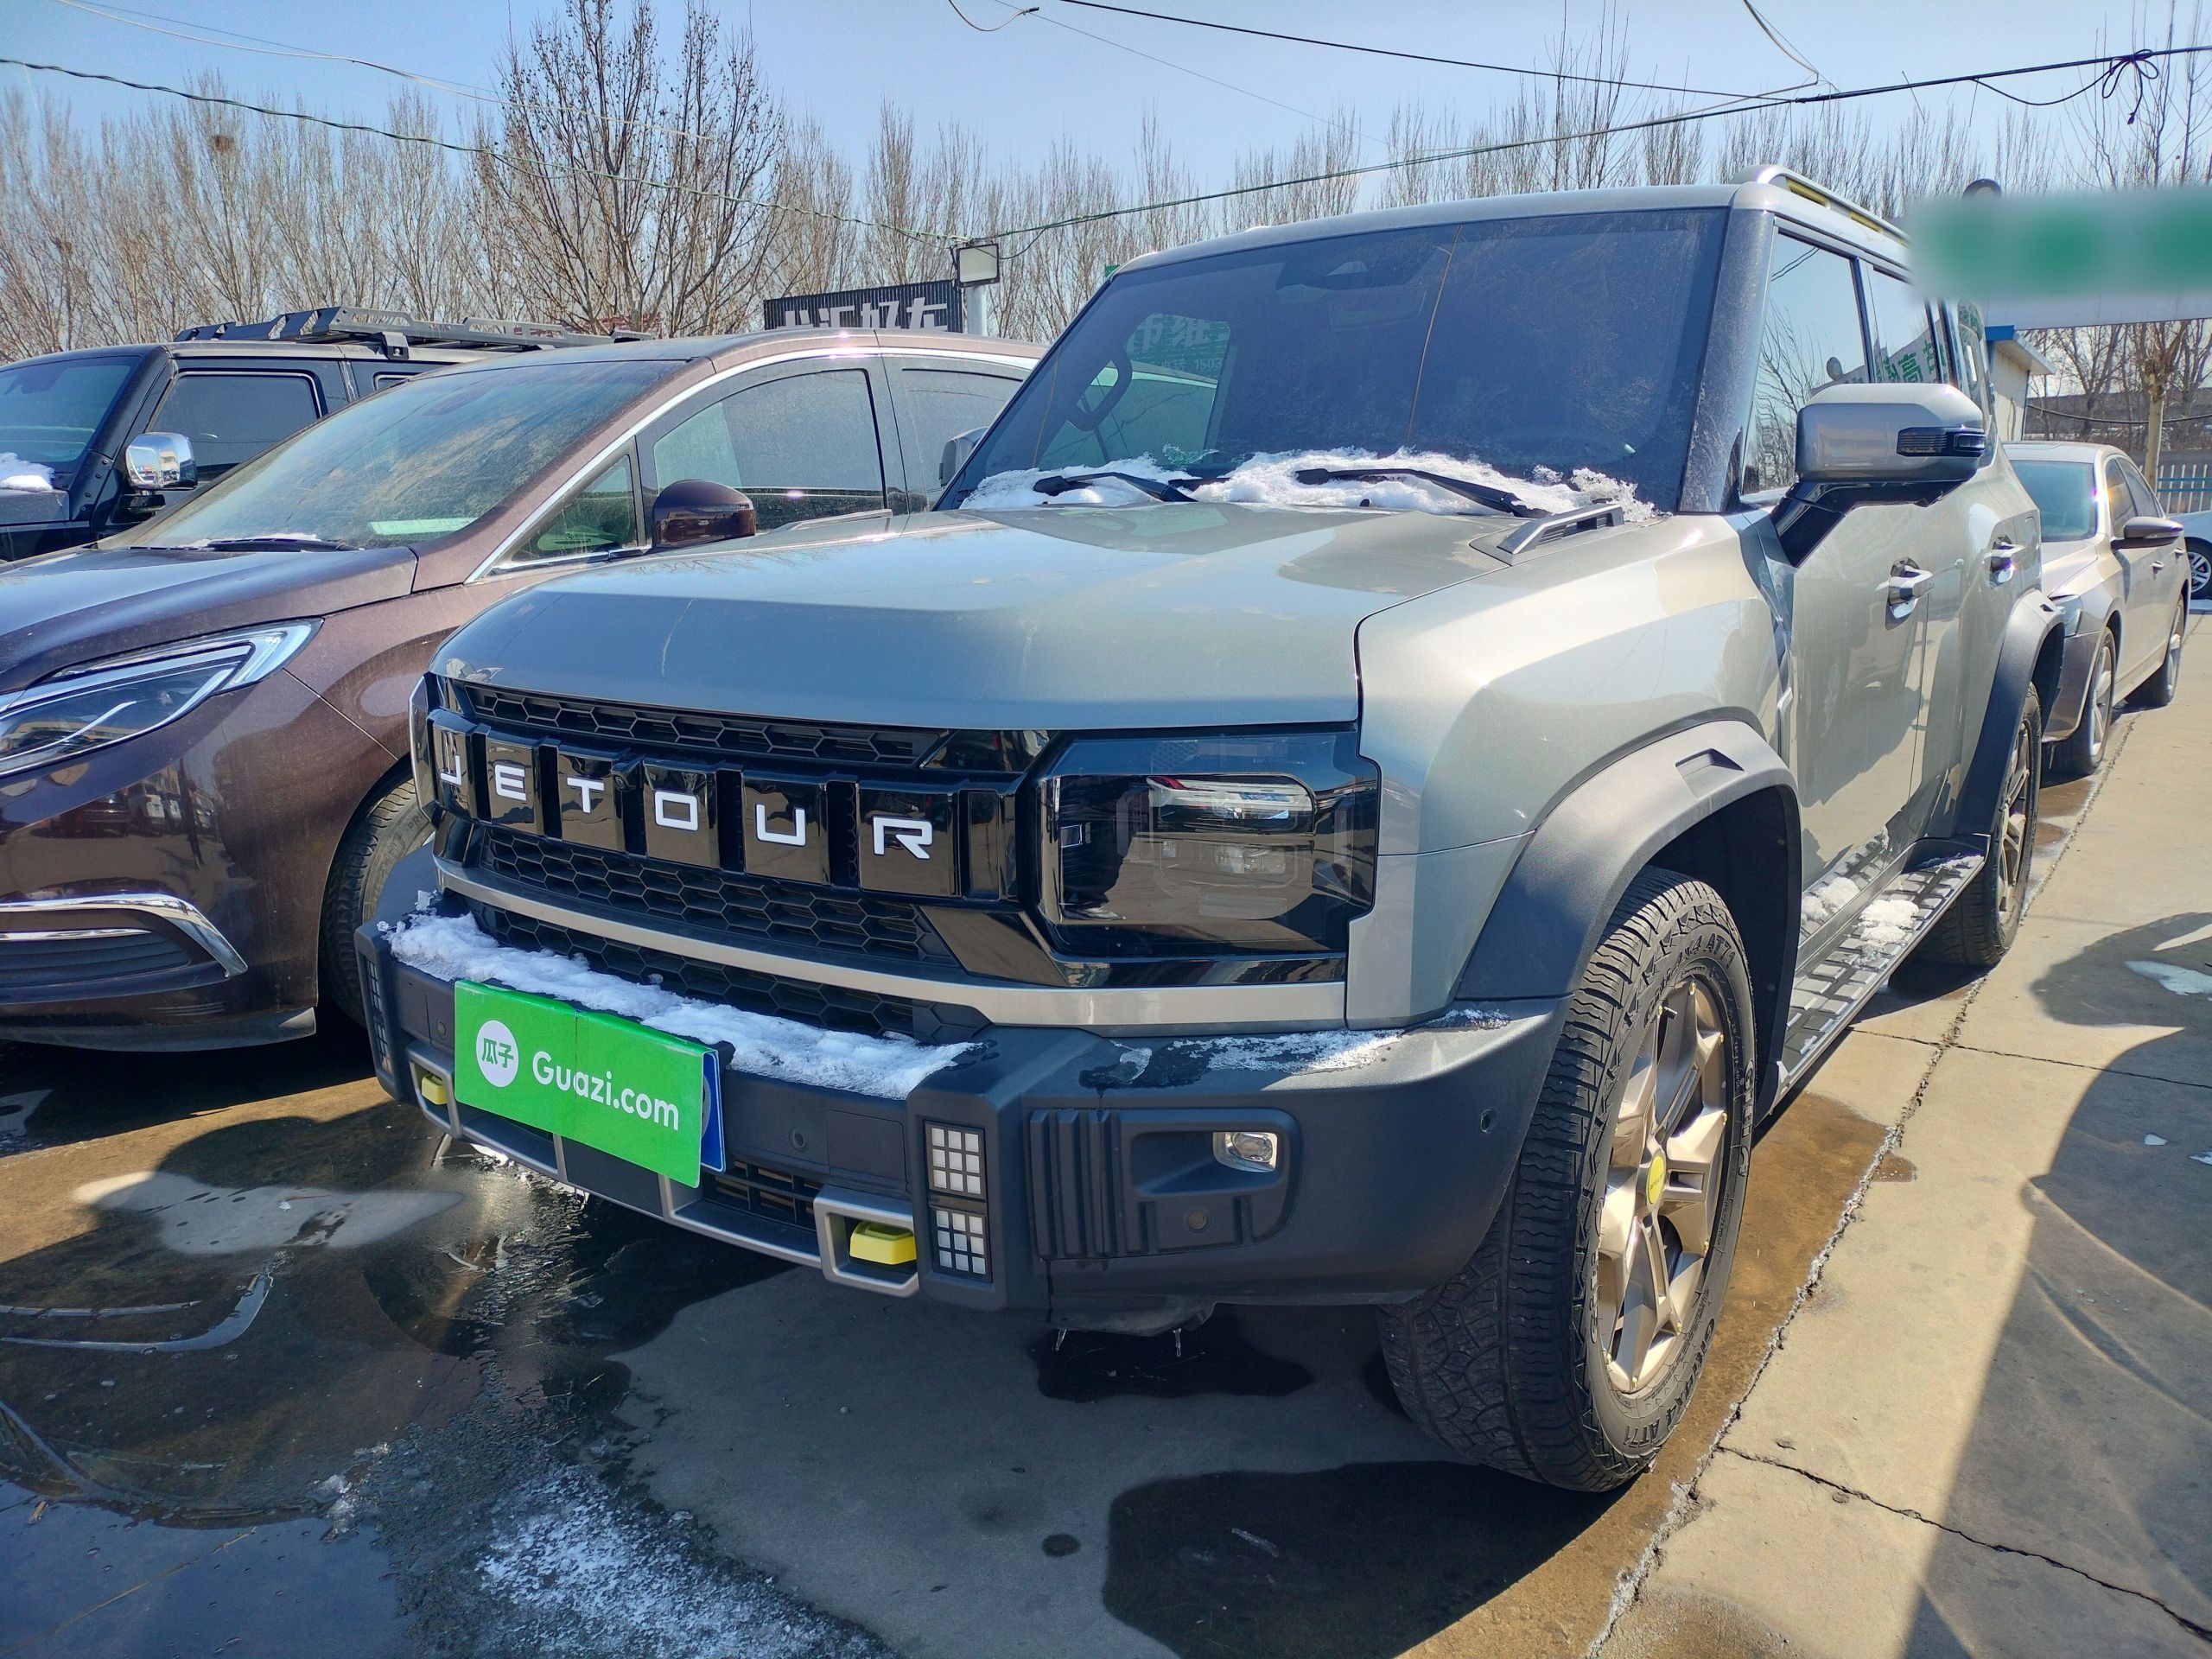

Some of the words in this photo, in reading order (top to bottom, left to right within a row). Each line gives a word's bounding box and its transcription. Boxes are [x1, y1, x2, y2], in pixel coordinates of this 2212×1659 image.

[440, 755, 934, 861] JETOUR
[481, 1037, 514, 1069] 瓜子
[531, 1050, 680, 1132] Guazi.com
